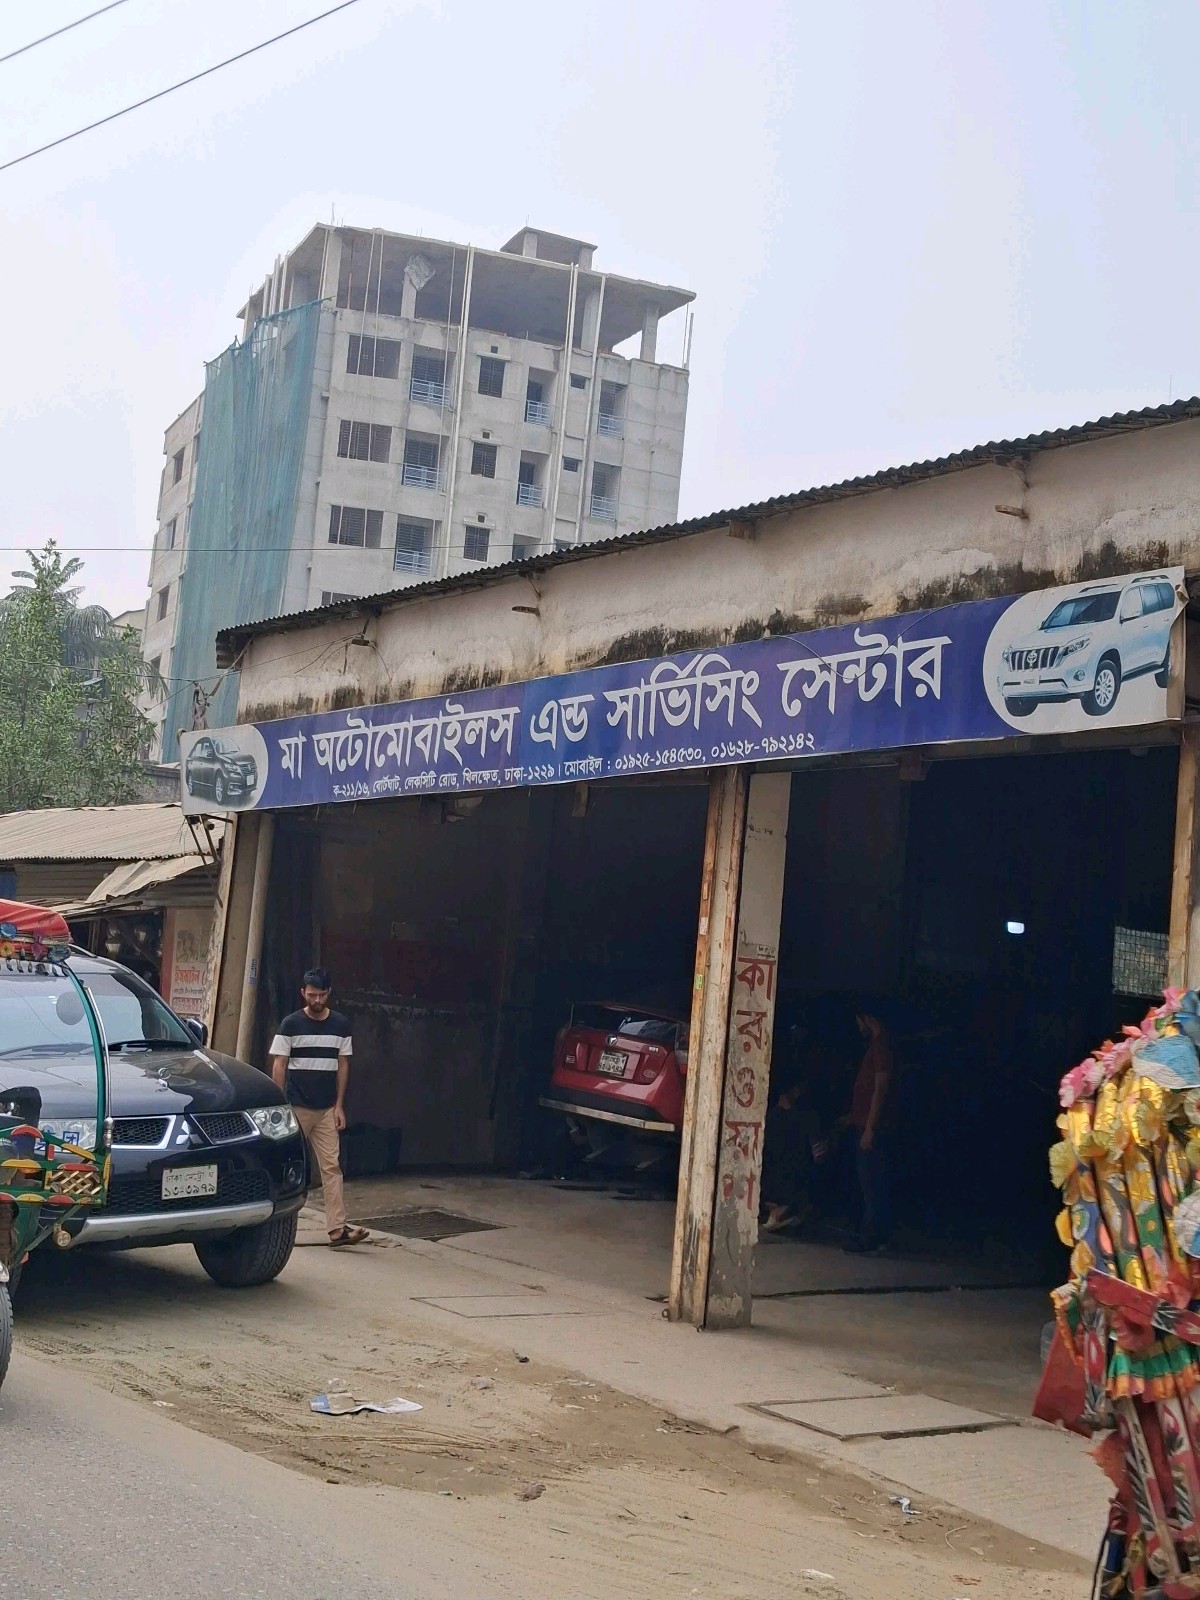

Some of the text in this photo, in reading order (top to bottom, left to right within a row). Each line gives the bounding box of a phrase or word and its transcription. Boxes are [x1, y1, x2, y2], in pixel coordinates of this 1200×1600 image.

[278, 627, 953, 780] মা অটোমোবাইলস এন্ড সার্ভিসিং সেন্টার
[404, 770, 438, 790] লেকসিটি
[462, 767, 501, 786] খিলক্ষেত,
[563, 754, 604, 776] মোবাইল
